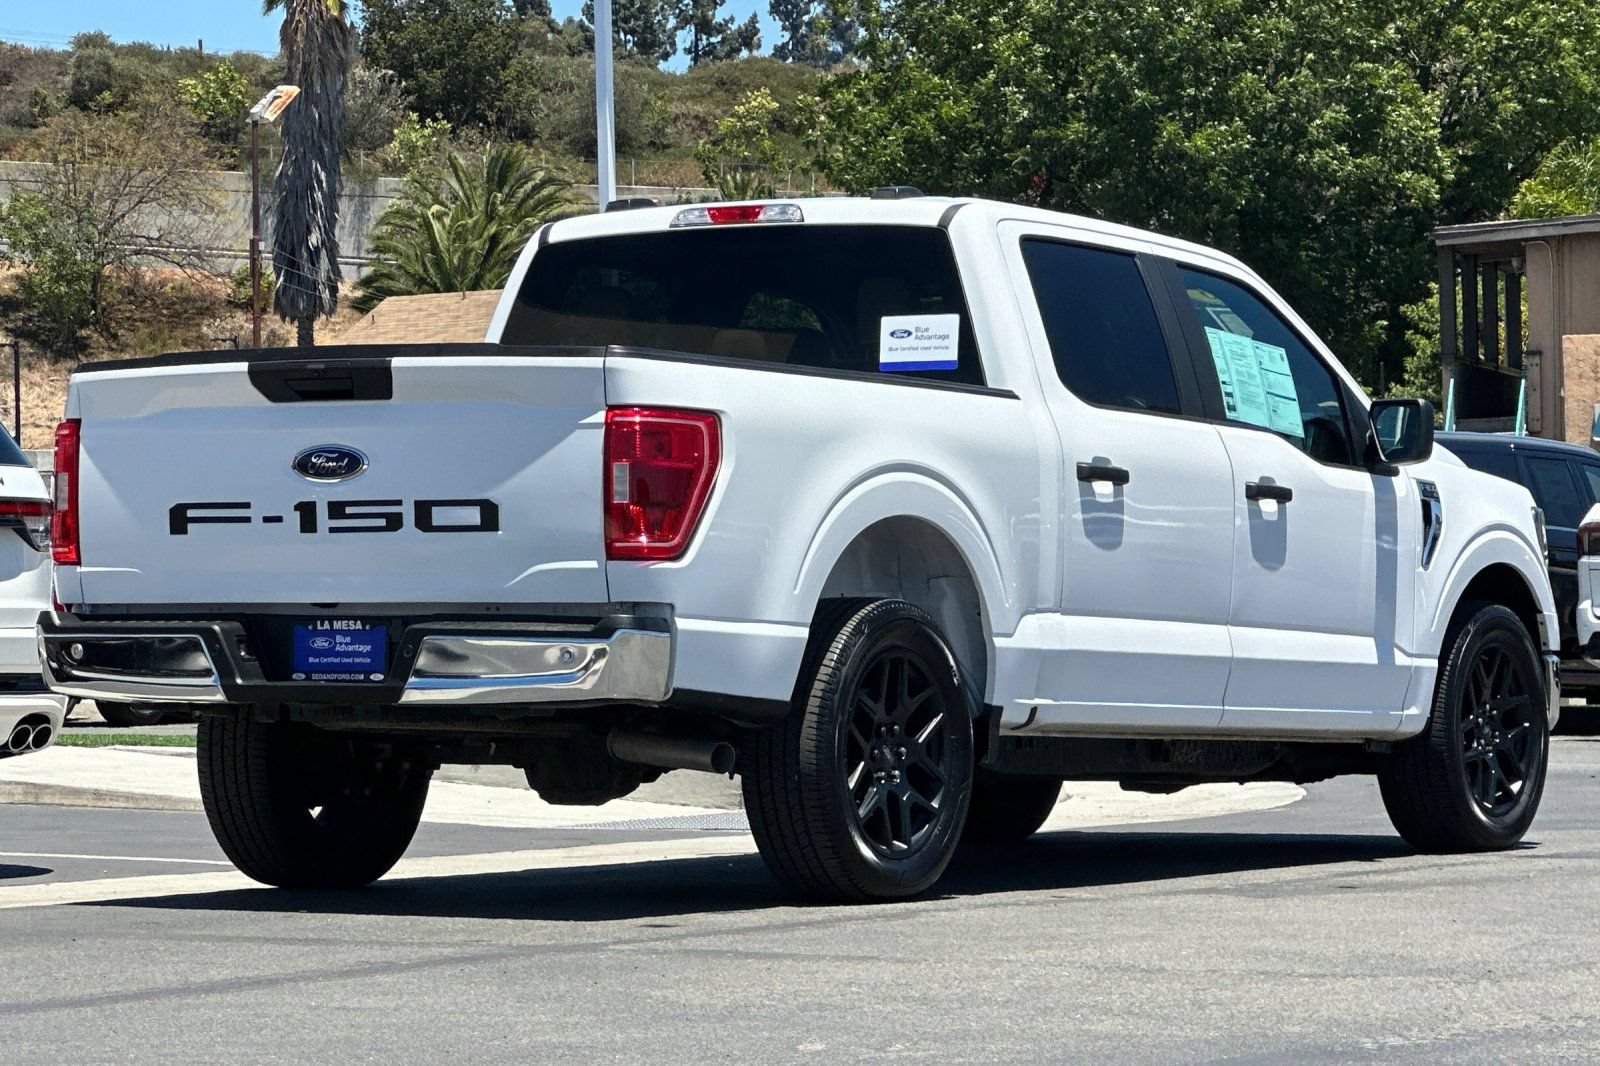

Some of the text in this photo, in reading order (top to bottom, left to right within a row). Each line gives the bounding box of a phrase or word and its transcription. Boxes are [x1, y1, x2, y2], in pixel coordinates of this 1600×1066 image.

[914, 326, 930, 334] Blue
[914, 333, 950, 341] Advantage
[306, 451, 349, 475] Ford
[168, 498, 500, 535] F-150
[316, 620, 363, 630] LA MESA
[335, 634, 351, 643] Blue
[335, 643, 372, 652] Advantage
